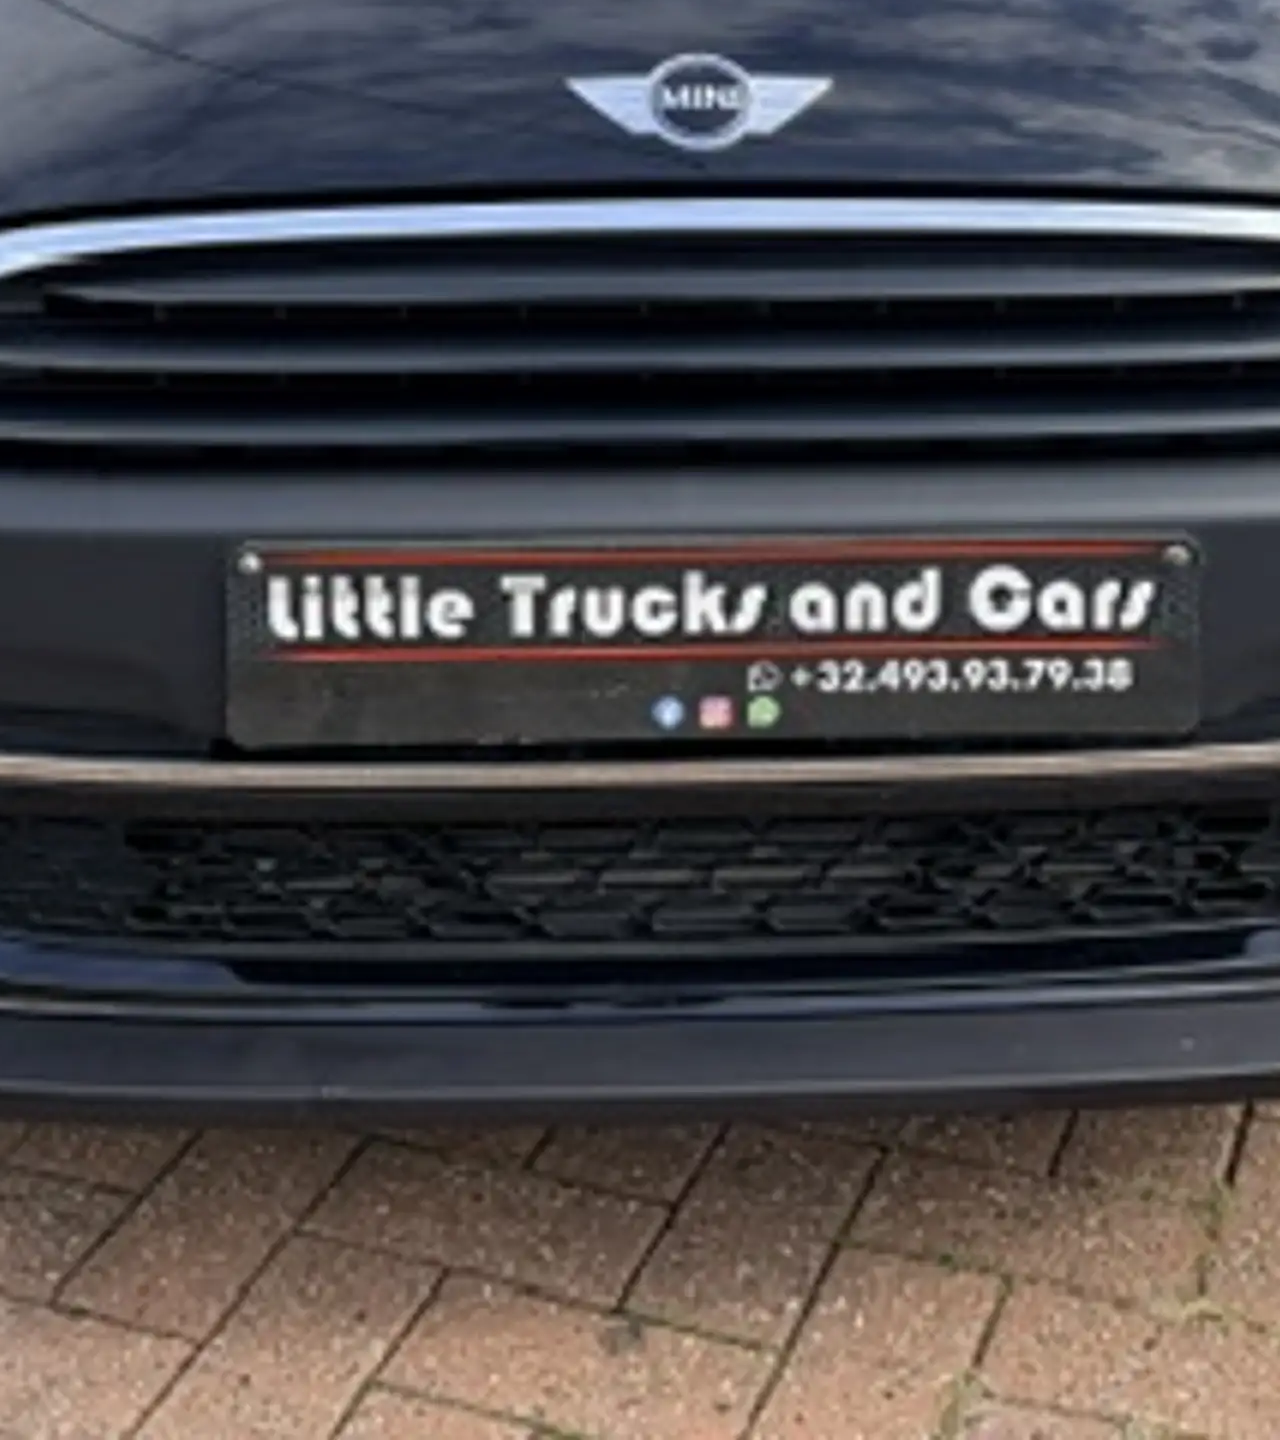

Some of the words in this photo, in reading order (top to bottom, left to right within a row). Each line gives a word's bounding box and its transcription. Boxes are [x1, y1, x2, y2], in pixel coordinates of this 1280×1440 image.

[662, 84, 742, 110] MINI
[267, 573, 475, 642] Little
[502, 570, 767, 638] Trucks
[789, 565, 941, 633] and
[967, 564, 1156, 630] Cars
